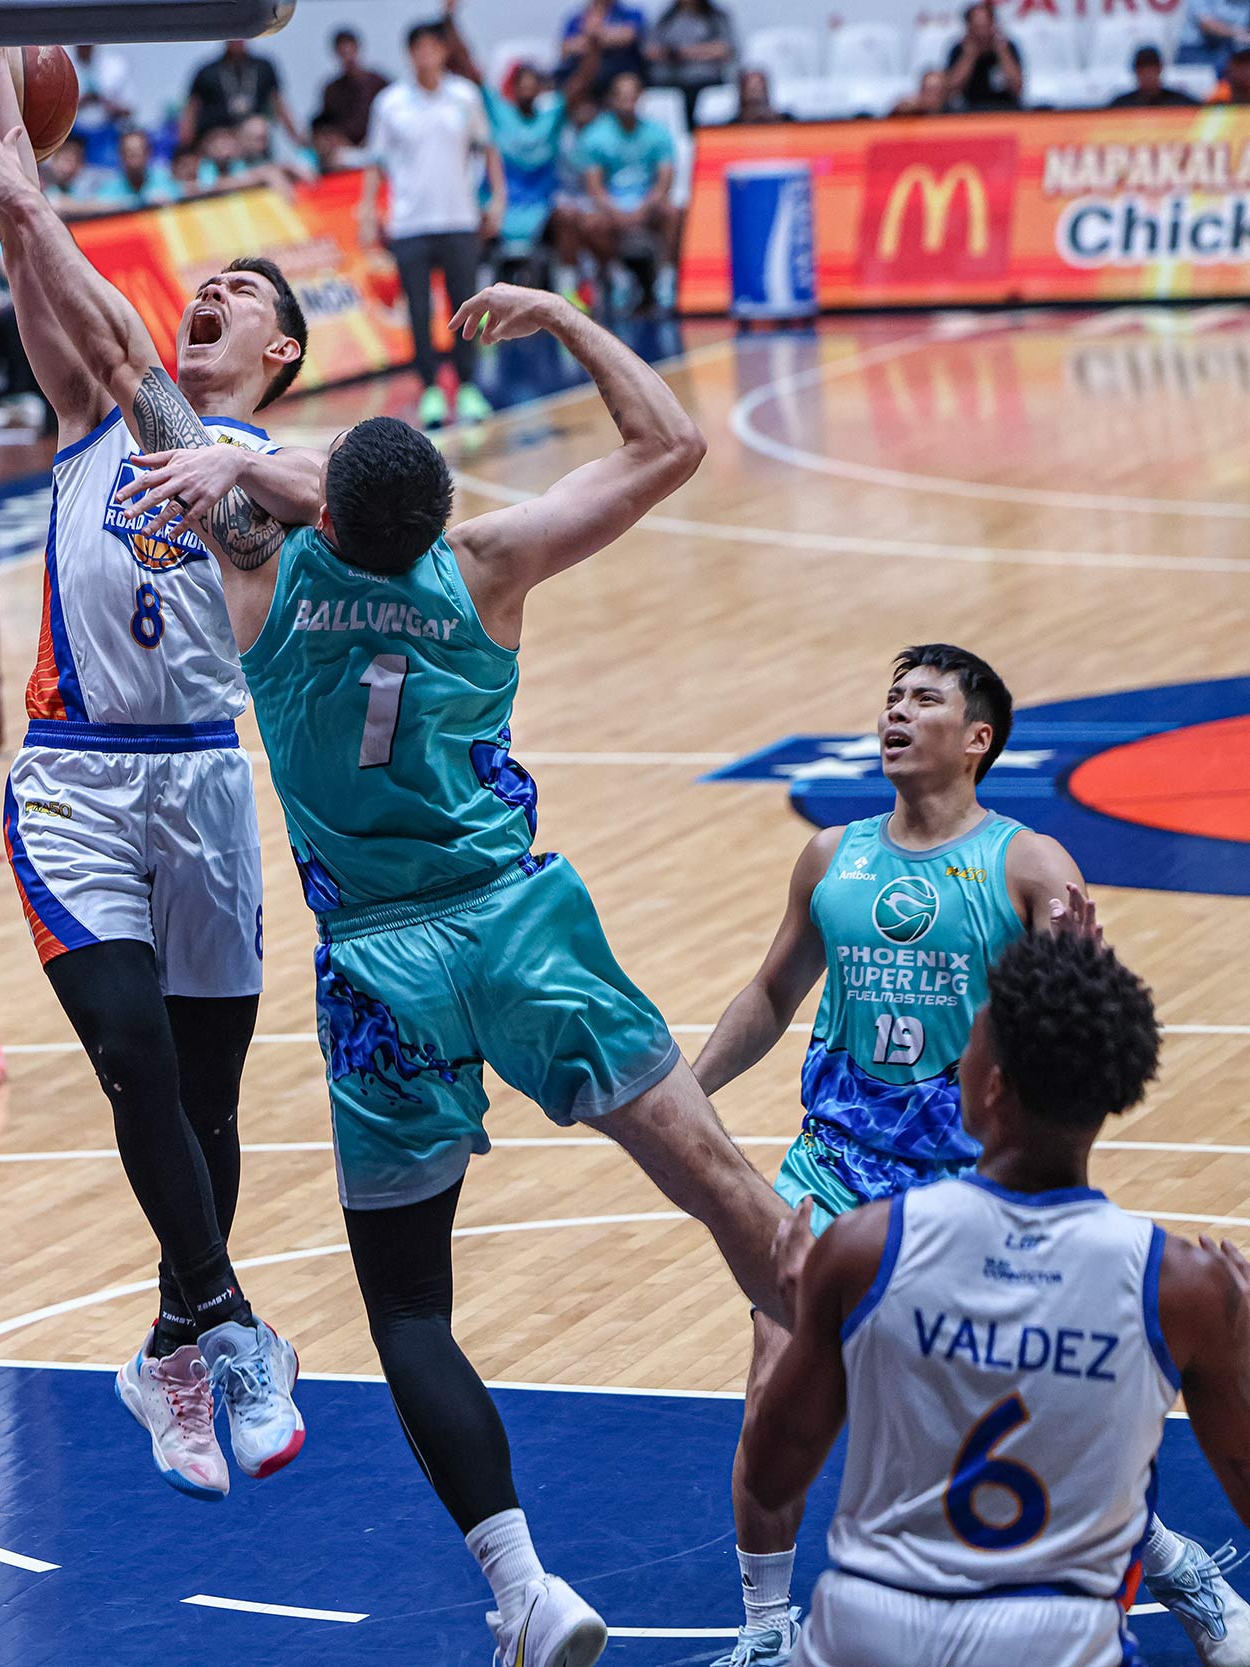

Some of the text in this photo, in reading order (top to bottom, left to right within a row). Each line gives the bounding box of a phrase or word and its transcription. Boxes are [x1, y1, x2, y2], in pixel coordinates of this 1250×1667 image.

[130, 581, 165, 650] 8
[294, 600, 459, 640] BALLUNGAY
[358, 654, 409, 769] 1
[839, 870, 877, 881] Antbox
[837, 946, 971, 972] PHOENIX
[843, 965, 970, 995] SUPER LPG
[873, 1013, 924, 1066] 19
[914, 1308, 1120, 1382] VALDEZ
[942, 1391, 1050, 1553] 6
